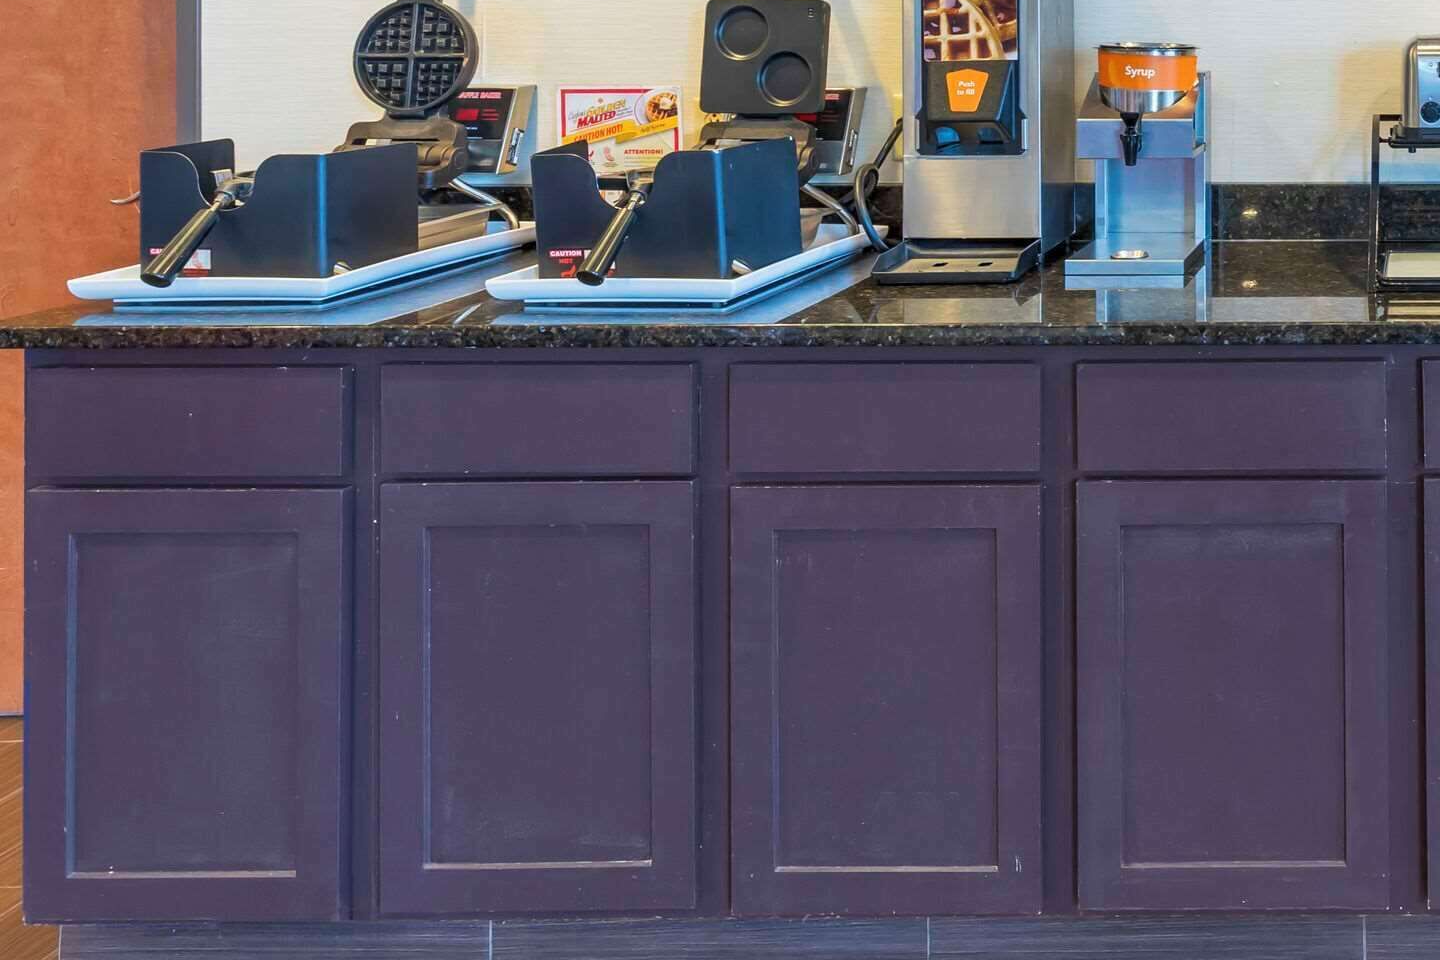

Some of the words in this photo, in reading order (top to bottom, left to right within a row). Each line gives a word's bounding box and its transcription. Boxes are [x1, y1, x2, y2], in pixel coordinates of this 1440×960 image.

[1125, 65, 1156, 79] Syrup
[577, 110, 617, 129] MALTED
[606, 123, 624, 137] HOT!
[549, 249, 582, 258] CAUTION
